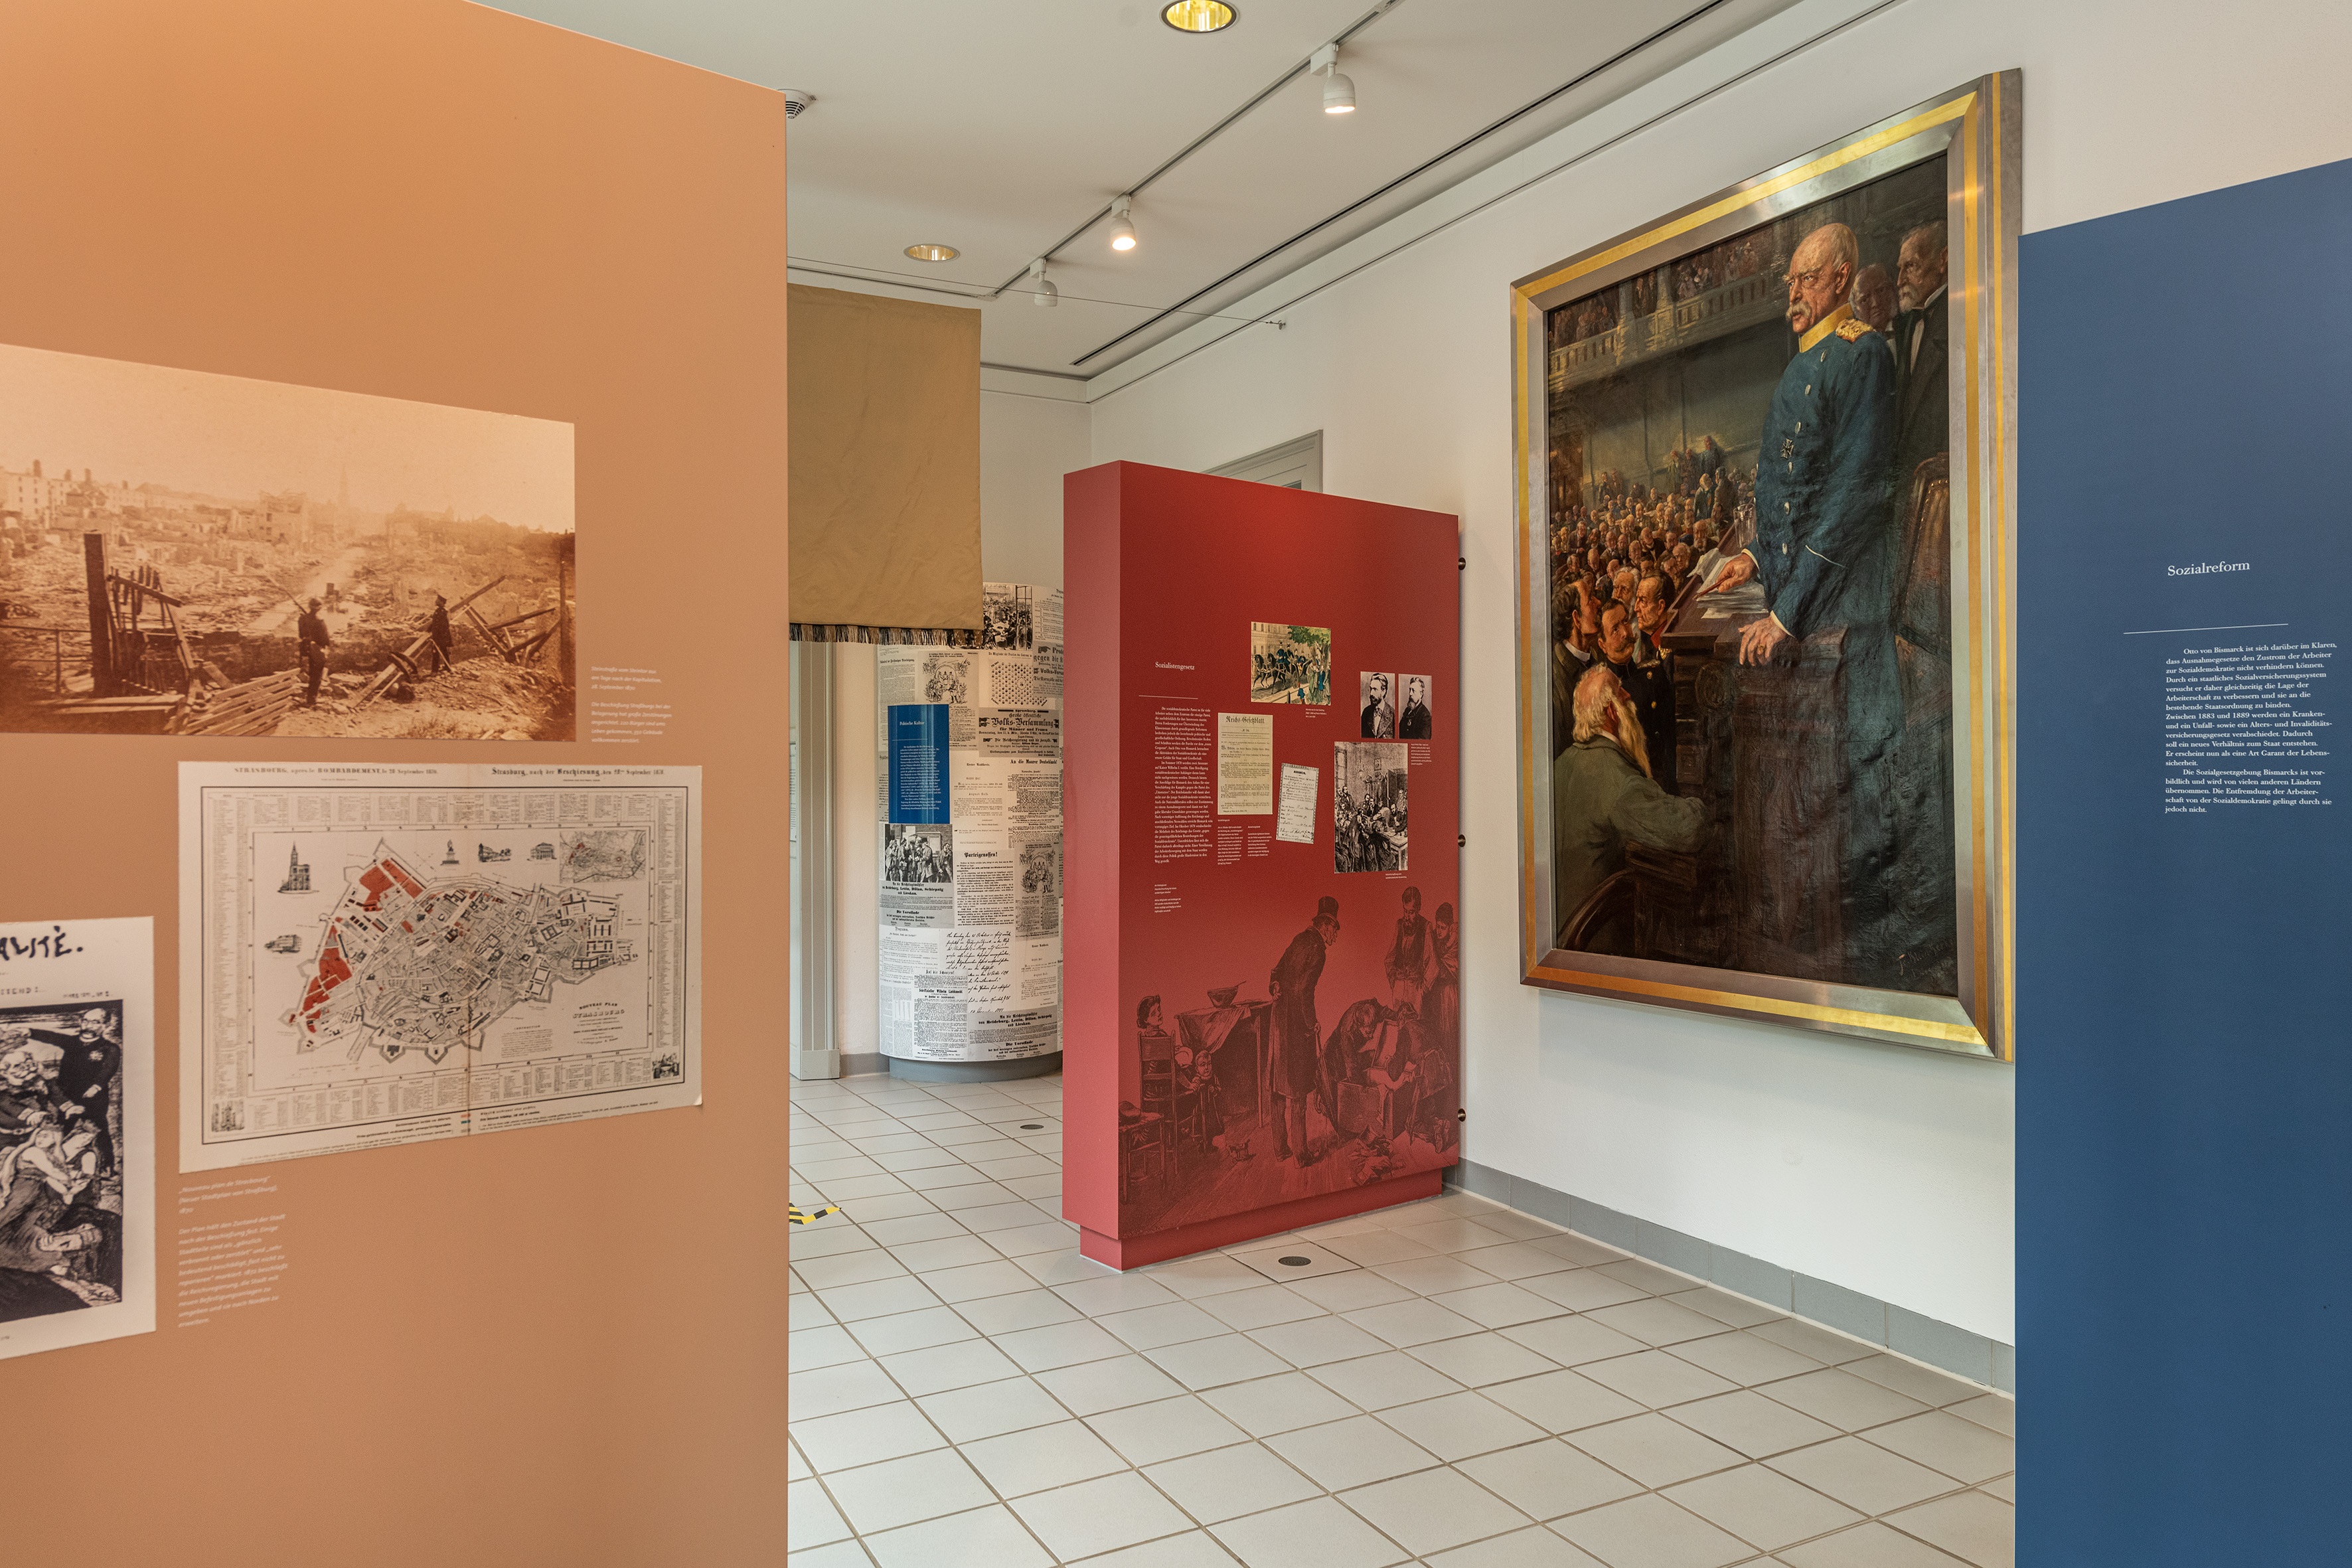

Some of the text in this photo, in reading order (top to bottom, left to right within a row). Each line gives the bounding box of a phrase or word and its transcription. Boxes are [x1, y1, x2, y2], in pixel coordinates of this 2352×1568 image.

[2168, 561, 2250, 576] Sozialreform
[1155, 661, 1195, 670] Sozialistengesetz
[2224, 683, 2263, 692] gleichzeitig
[991, 717, 1054, 728] Volks-Versammlung
